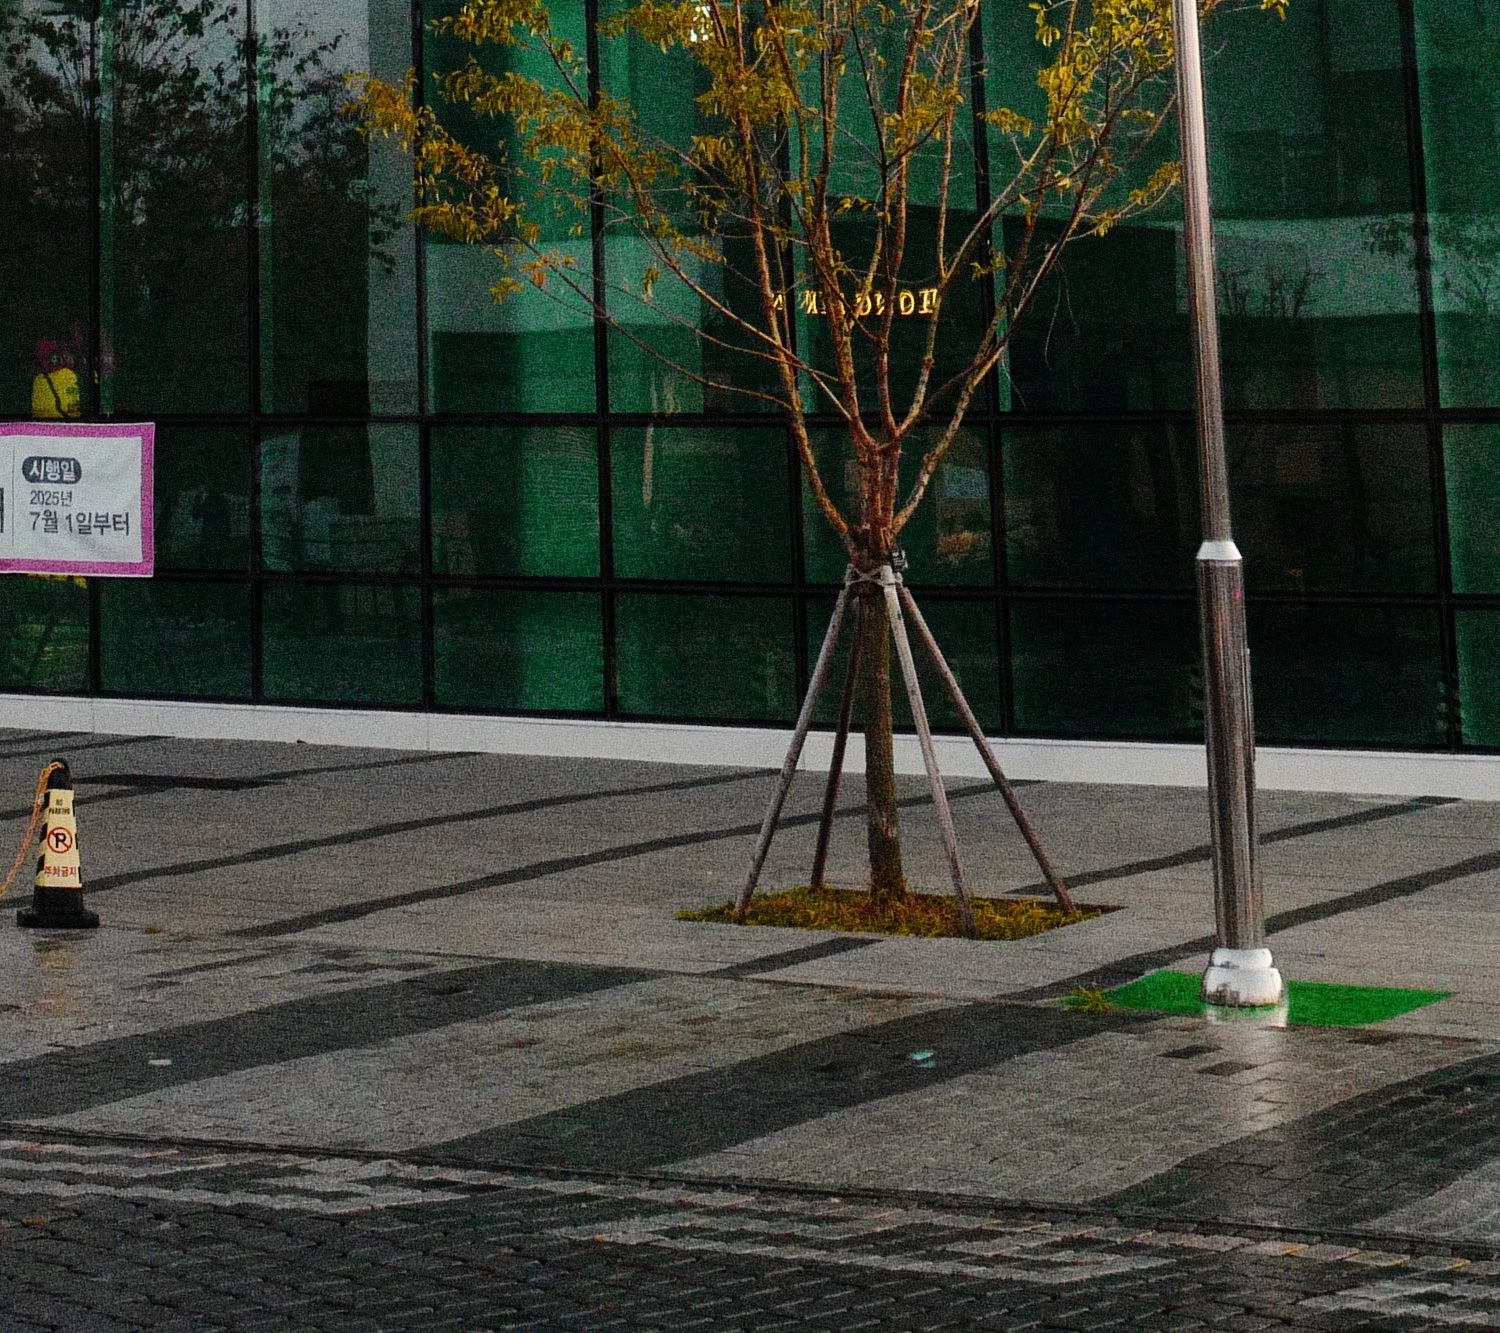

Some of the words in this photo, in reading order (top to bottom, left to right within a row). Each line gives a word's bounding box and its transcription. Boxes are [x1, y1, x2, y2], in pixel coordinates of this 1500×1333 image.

[29, 458, 78, 482] 시행일
[30, 489, 73, 506] 2025년
[30, 511, 59, 533] 7월
[65, 511, 130, 536] 1일부터
[44, 866, 77, 877] 주차금지
